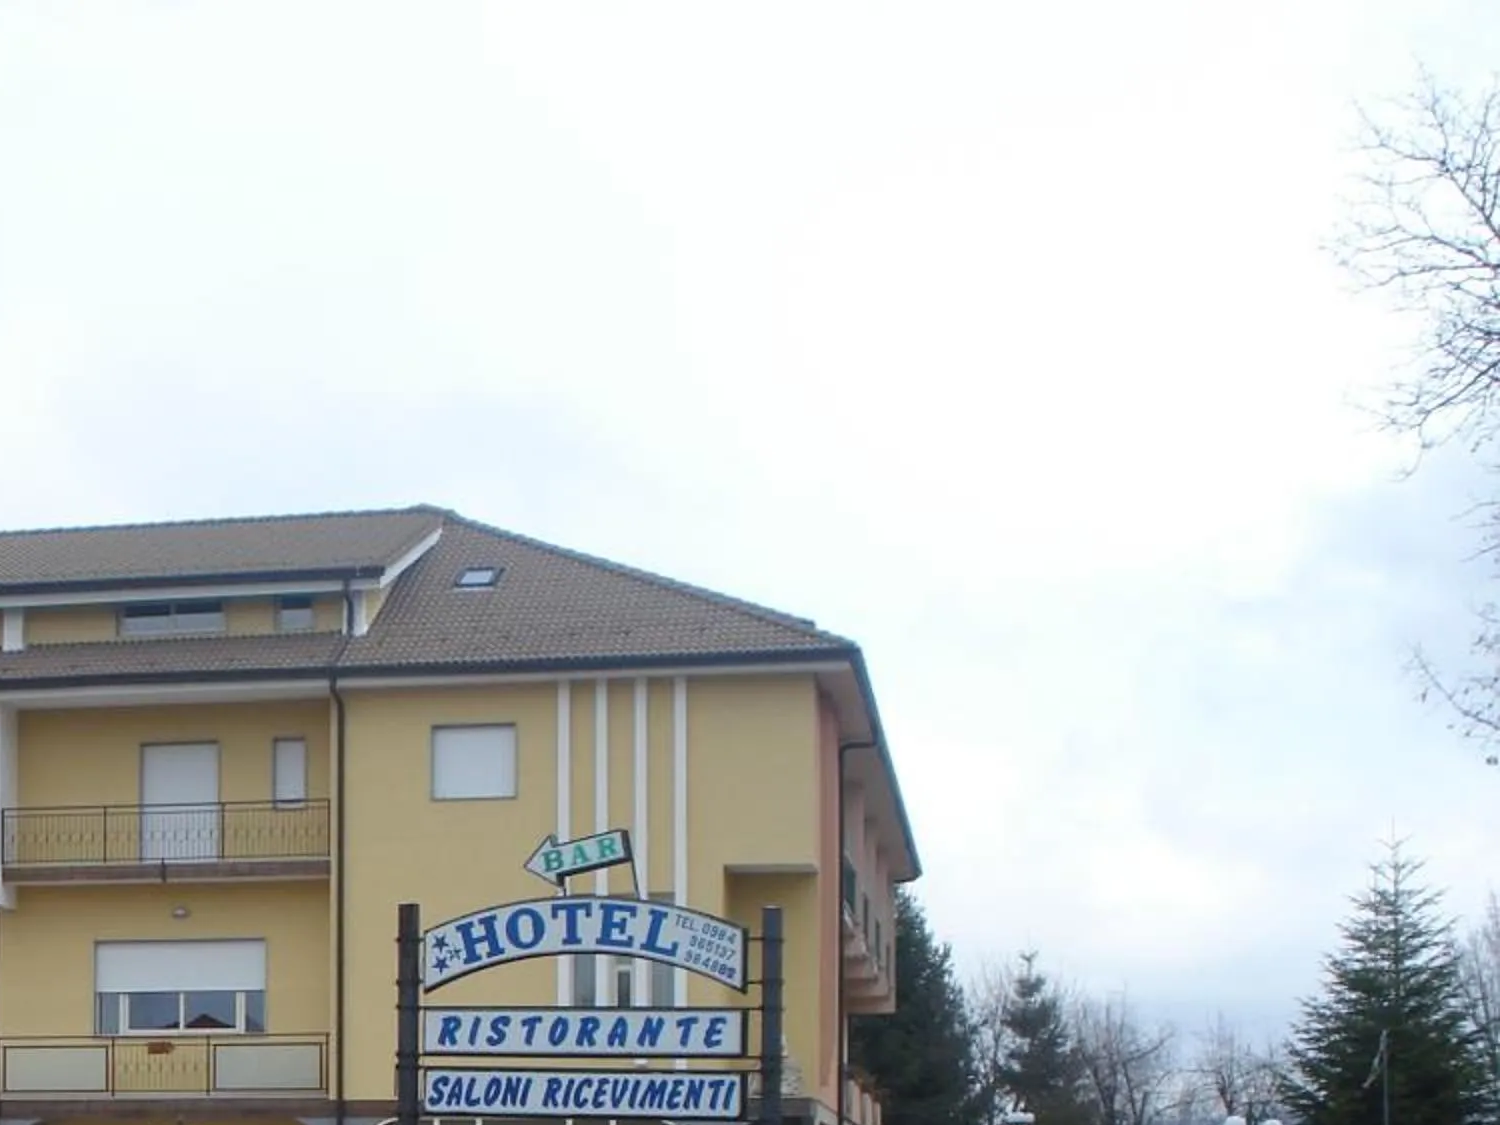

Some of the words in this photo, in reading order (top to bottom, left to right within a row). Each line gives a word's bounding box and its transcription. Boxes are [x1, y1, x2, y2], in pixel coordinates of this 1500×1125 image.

[542, 837, 618, 872] BAR
[456, 902, 679, 964] HOTEL
[438, 1015, 727, 1048] RISTORANTE
[428, 1075, 533, 1108] SALONI
[541, 1077, 736, 1110] RICEVIMENTI
